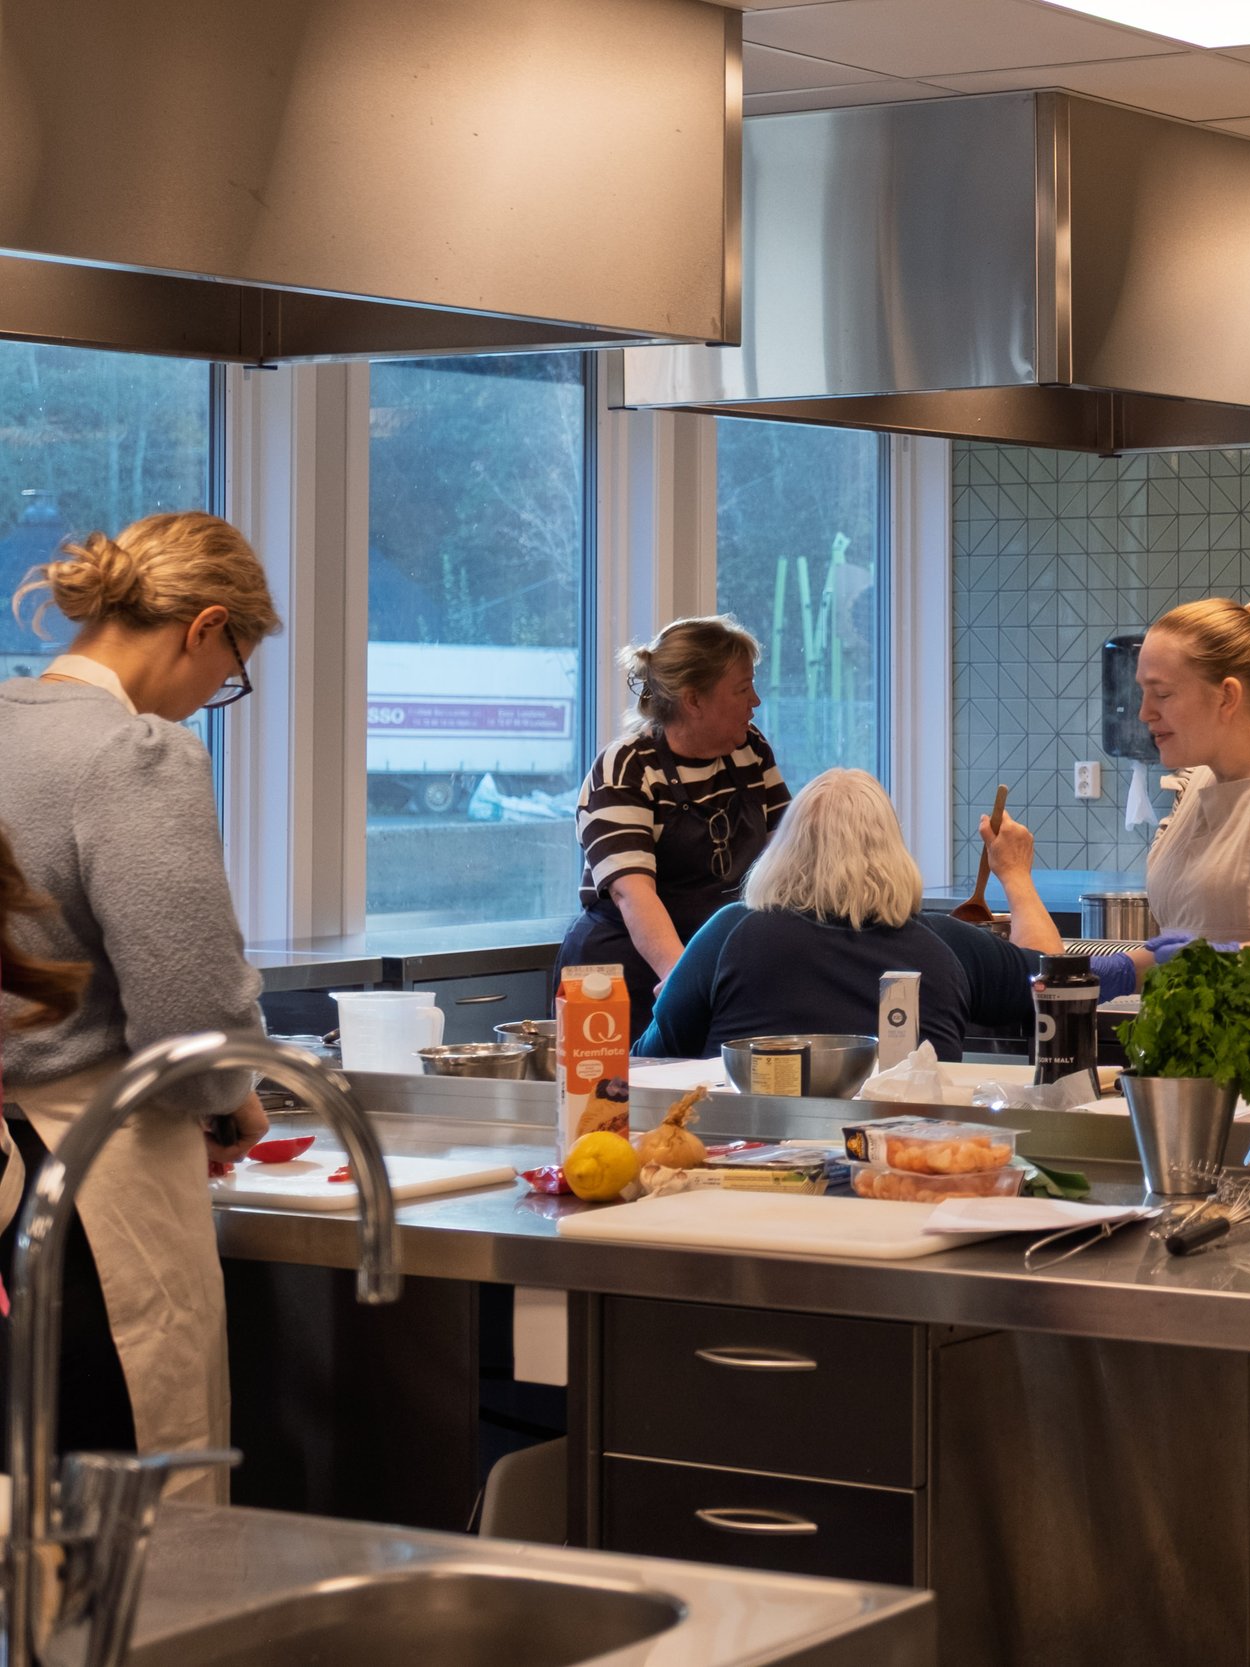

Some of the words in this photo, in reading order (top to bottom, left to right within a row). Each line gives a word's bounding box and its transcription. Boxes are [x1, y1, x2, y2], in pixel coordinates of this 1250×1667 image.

[582, 1011, 622, 1043] Q
[573, 1047, 625, 1058] Kremfløte
[1053, 1056, 1075, 1064] MALT
